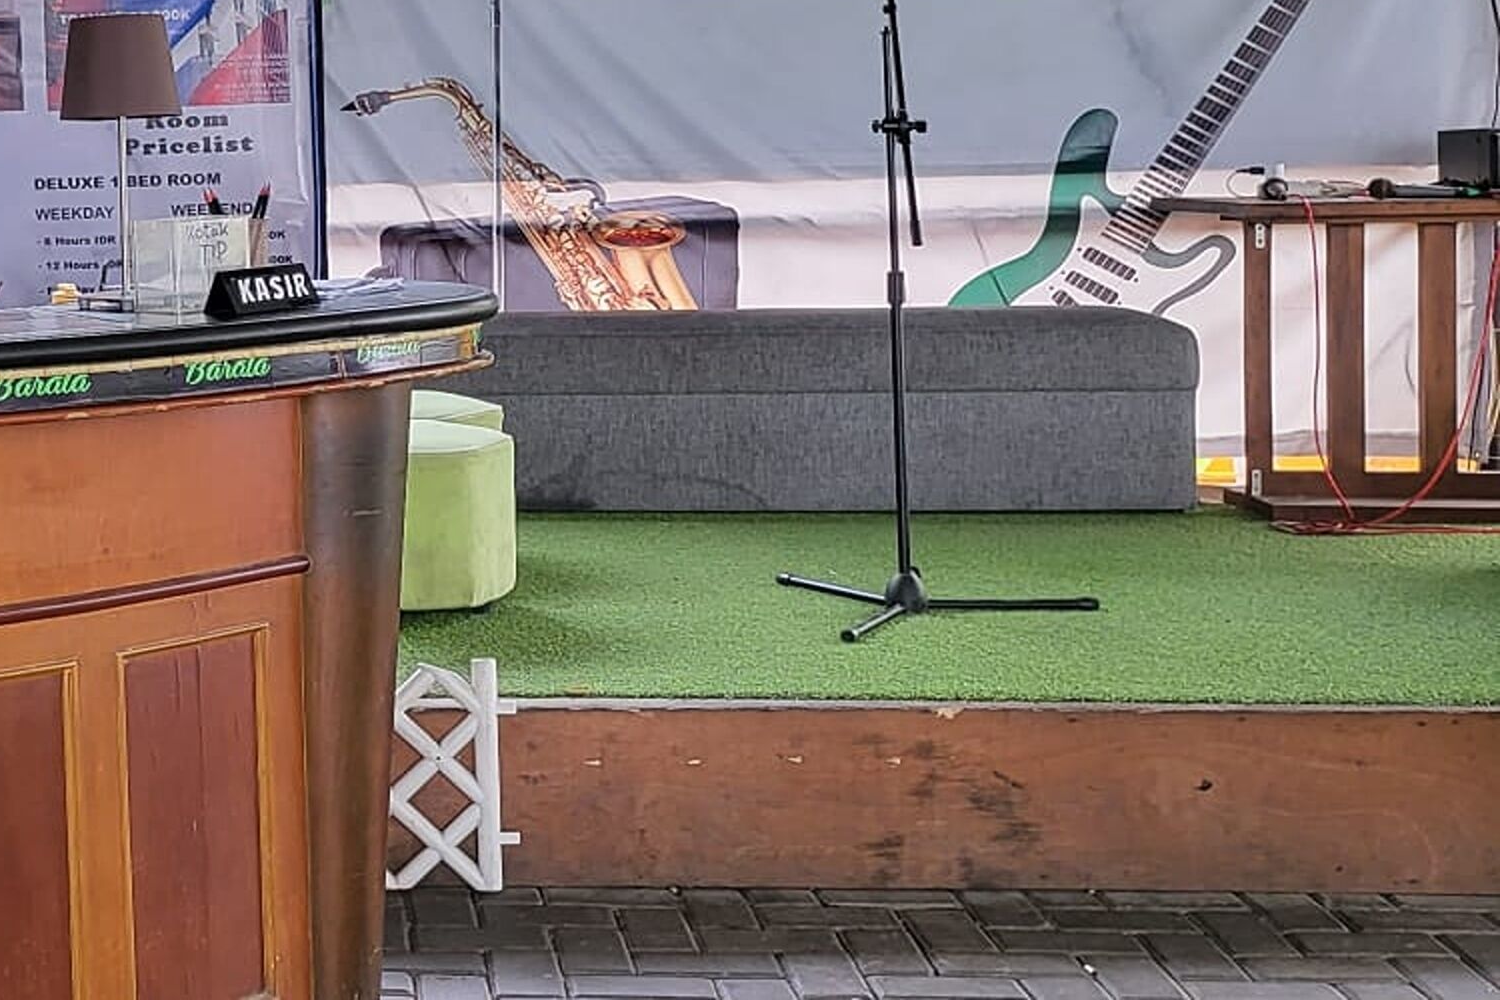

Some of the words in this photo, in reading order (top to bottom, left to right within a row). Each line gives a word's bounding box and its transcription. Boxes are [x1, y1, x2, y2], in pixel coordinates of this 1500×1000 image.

[146, 115, 229, 130] Room
[126, 136, 254, 155] Pricelist
[35, 176, 105, 190] DELUXE
[127, 175, 162, 188] BED
[167, 173, 221, 186] ROOM
[35, 206, 115, 220] WEEKDAY
[171, 203, 253, 217] WEEEND
[63, 261, 100, 270] Hours
[238, 273, 309, 304] KASIR
[185, 356, 271, 385] Barata
